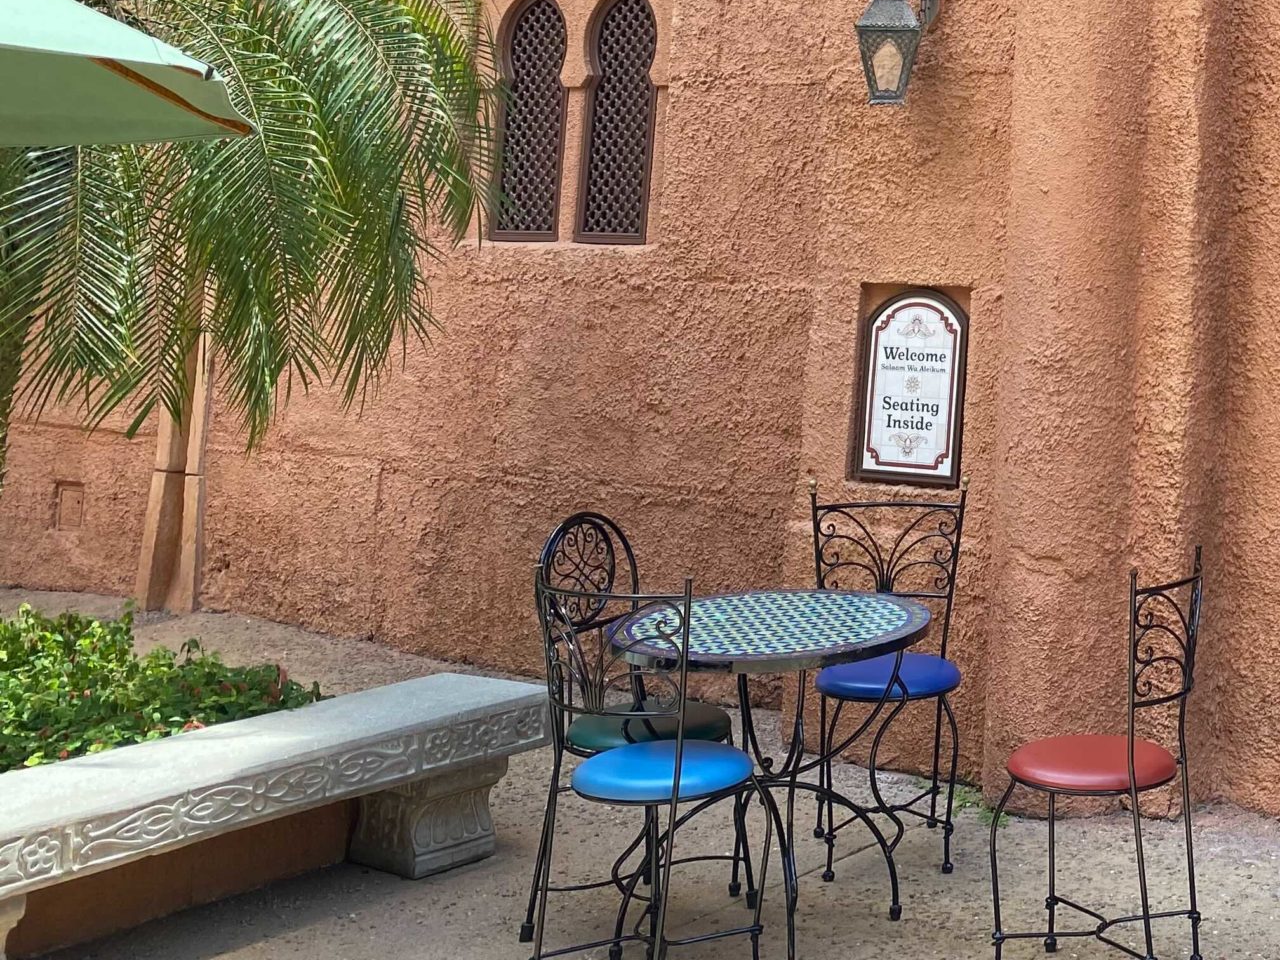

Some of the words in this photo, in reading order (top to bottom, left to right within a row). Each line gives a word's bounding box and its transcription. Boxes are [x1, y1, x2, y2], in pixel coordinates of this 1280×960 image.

[883, 346, 947, 362] Welcome
[882, 396, 939, 416] Seating
[886, 414, 933, 431] Inside
